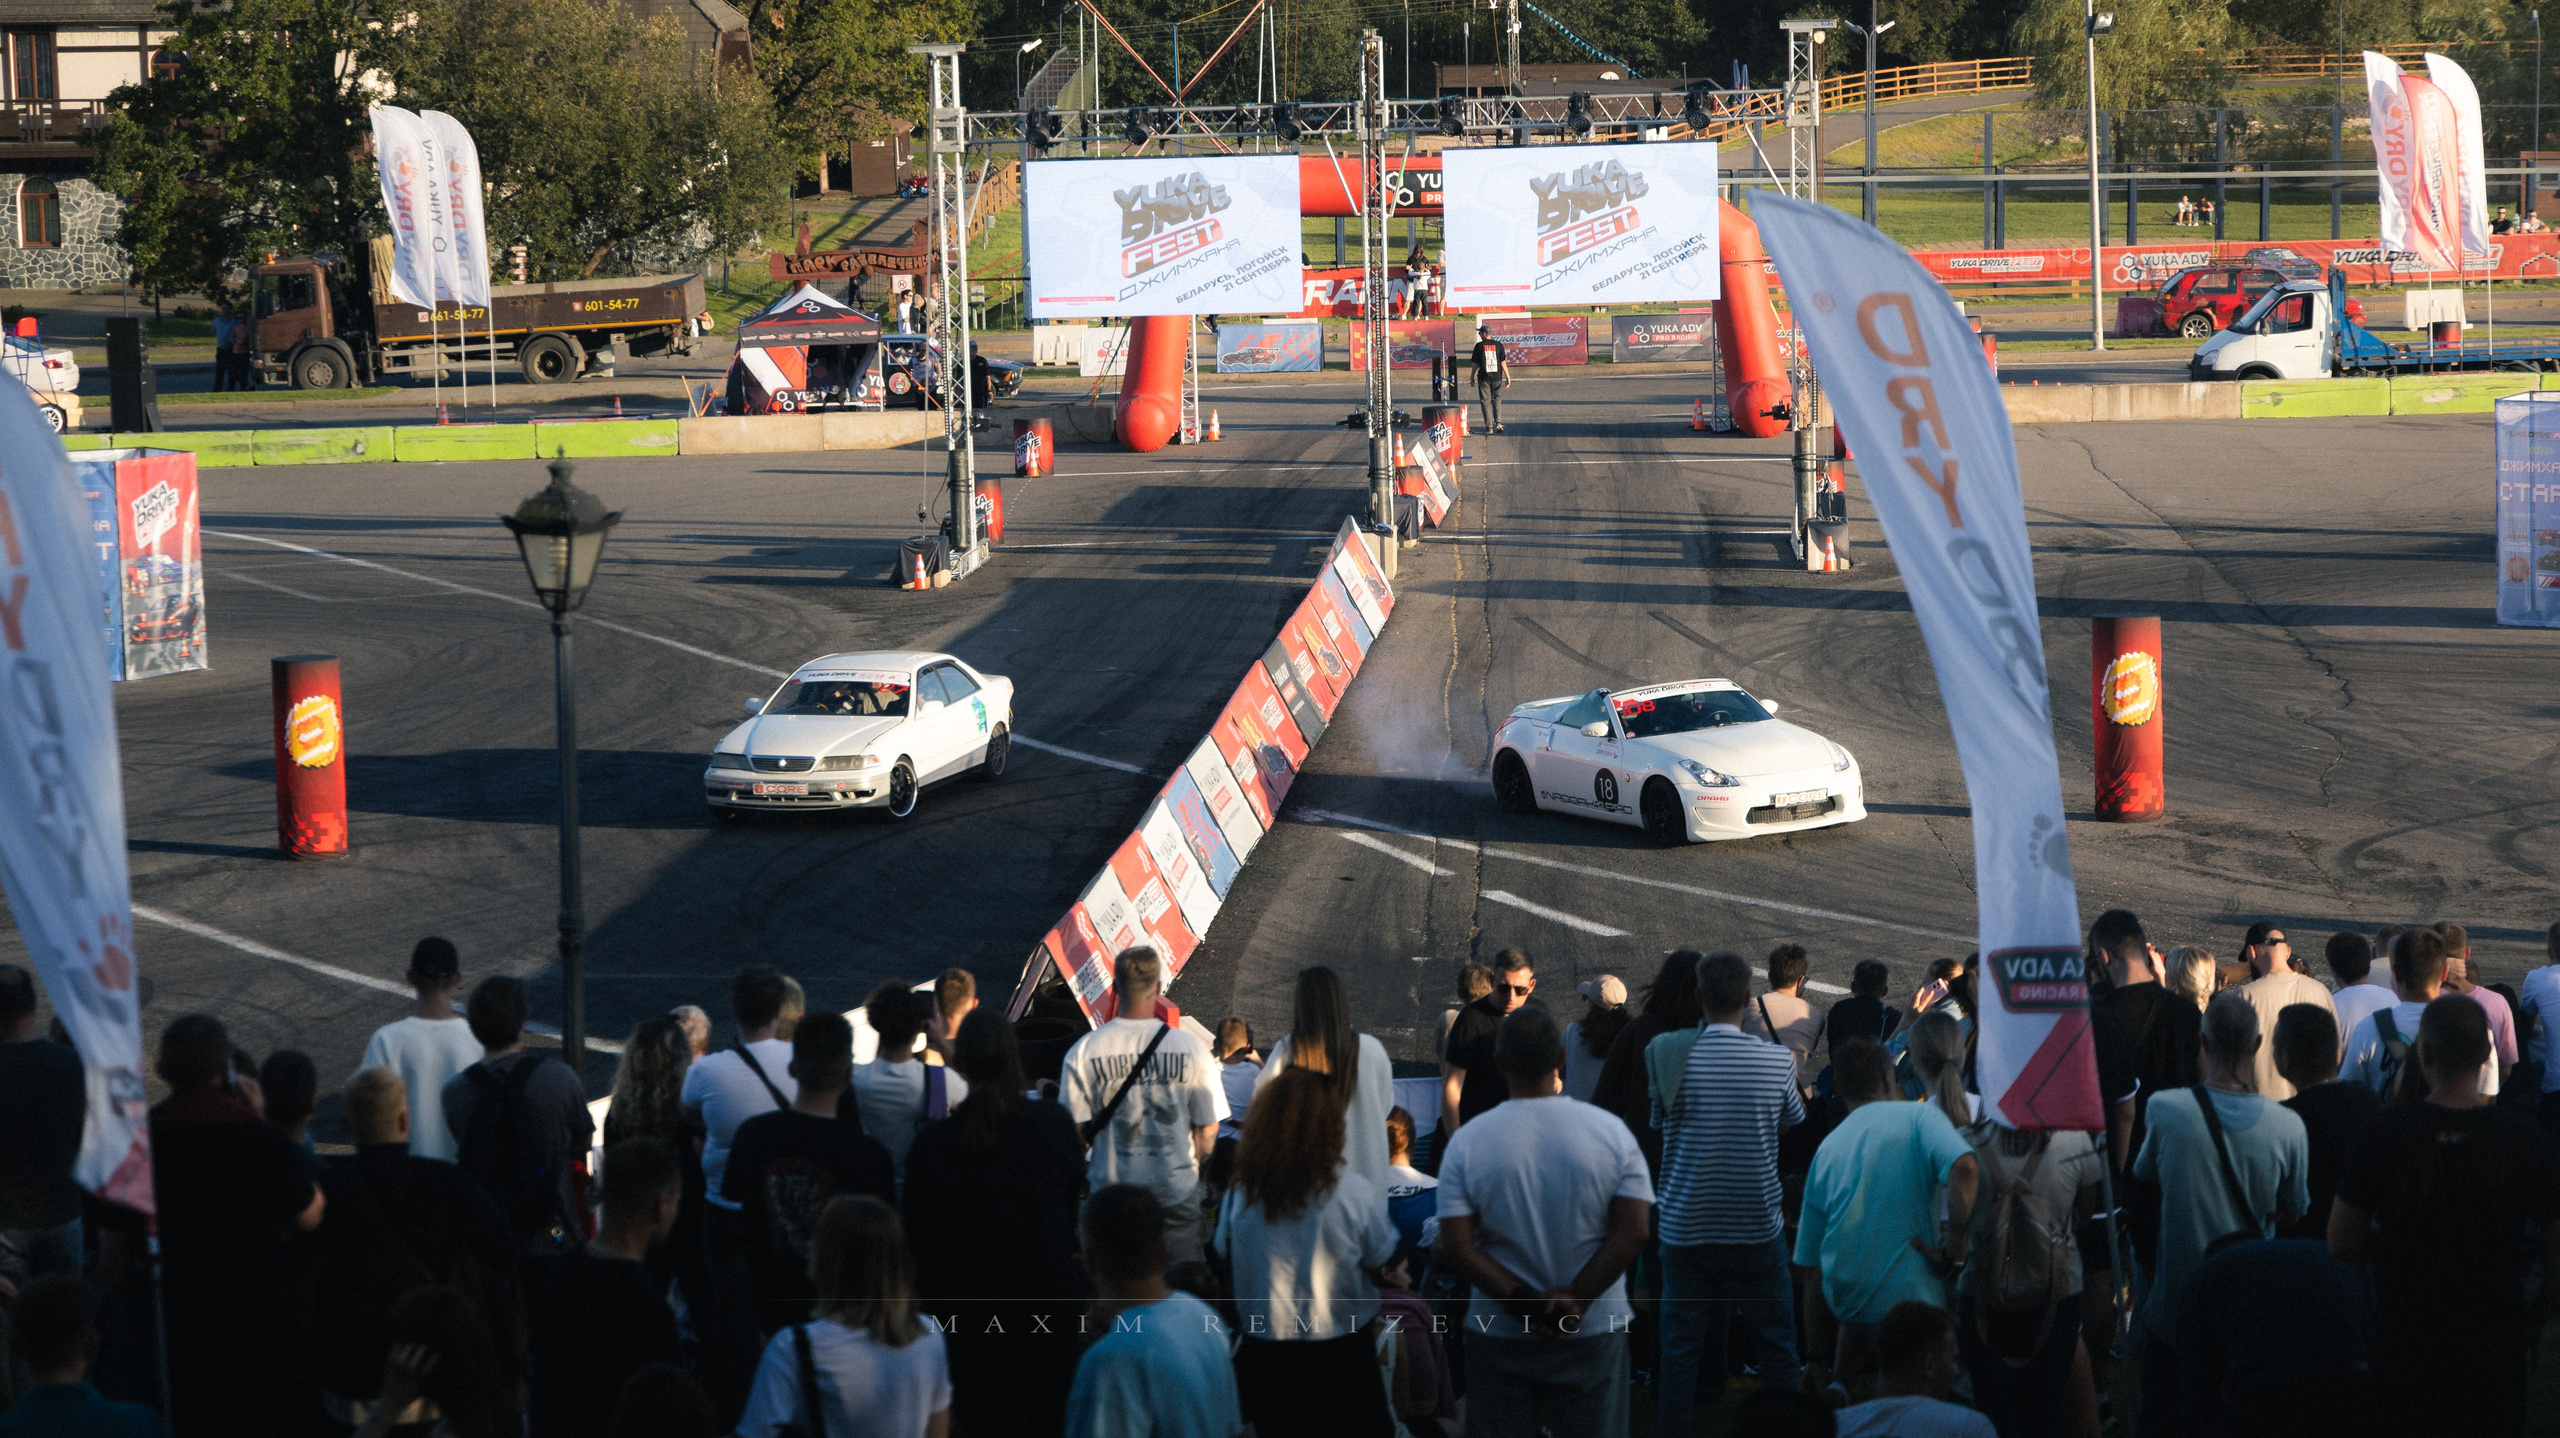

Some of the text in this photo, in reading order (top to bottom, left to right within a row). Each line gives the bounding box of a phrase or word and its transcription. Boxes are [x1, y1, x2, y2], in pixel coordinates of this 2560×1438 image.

[1543, 208, 1634, 264] FEST
[1126, 219, 1217, 276] FEST
[2335, 249, 2385, 264] YUKA
[789, 254, 838, 275] ПАРК
[1592, 233, 1707, 293] БЕЛАРУСЬ, ЛОГОЙСК
[1639, 243, 1709, 281] 21 СЕНТЯБРЯ
[1950, 259, 1977, 267] YUKA
[1979, 258, 2011, 267] DRIVE
[2143, 254, 2209, 266] YUKA ADV
[1176, 245, 1289, 304] БЕЛАРУСЬ, ЛОГОЙСК
[1223, 256, 1292, 292] 21 СЕНТЯБРЯ
[584, 298, 639, 312] 601-54-77
[1516, 334, 1546, 342] DRIVE
[1649, 323, 1703, 333] YUKA ADV
[134, 484, 168, 514] YUKA
[137, 491, 176, 527] DRIVE
[1637, 688, 1661, 697] YUKA
[1661, 684, 1687, 693] DRIVE
[765, 784, 807, 794] CORE
[1599, 777, 1614, 801] 18
[1788, 789, 1827, 803] CORE
